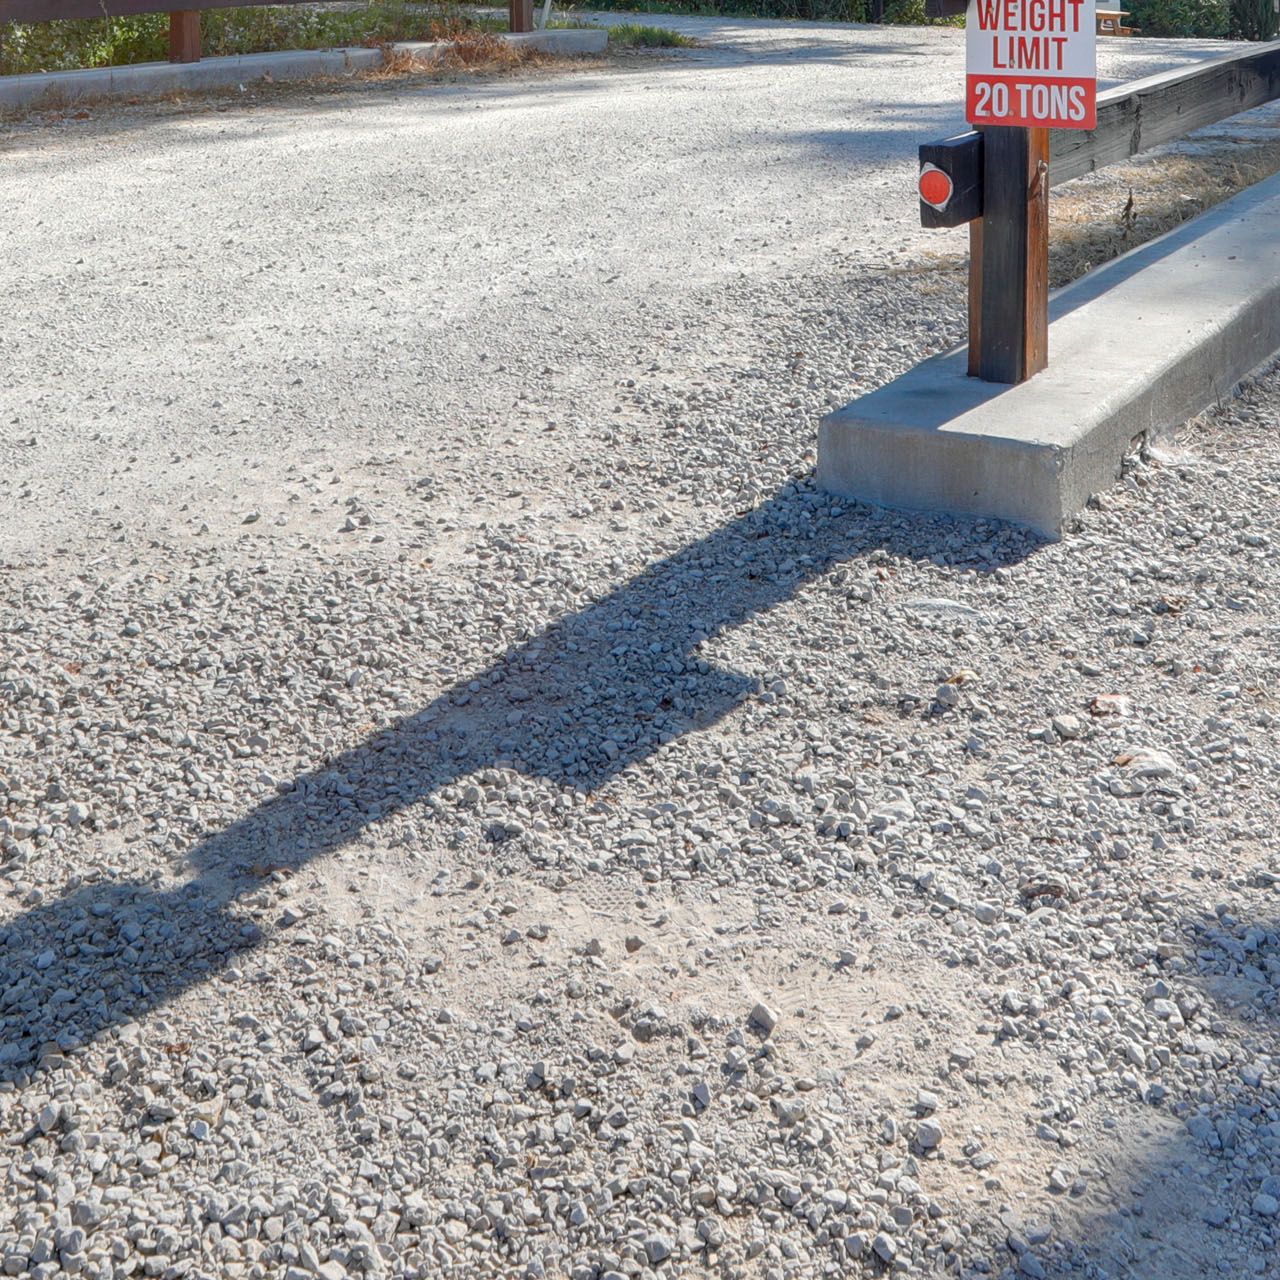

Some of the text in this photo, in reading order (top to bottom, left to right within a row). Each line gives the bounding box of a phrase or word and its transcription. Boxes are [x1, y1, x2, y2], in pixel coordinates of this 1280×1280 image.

[992, 36, 1068, 70] LIMIT
[975, 82, 1086, 121] 20 TONS
